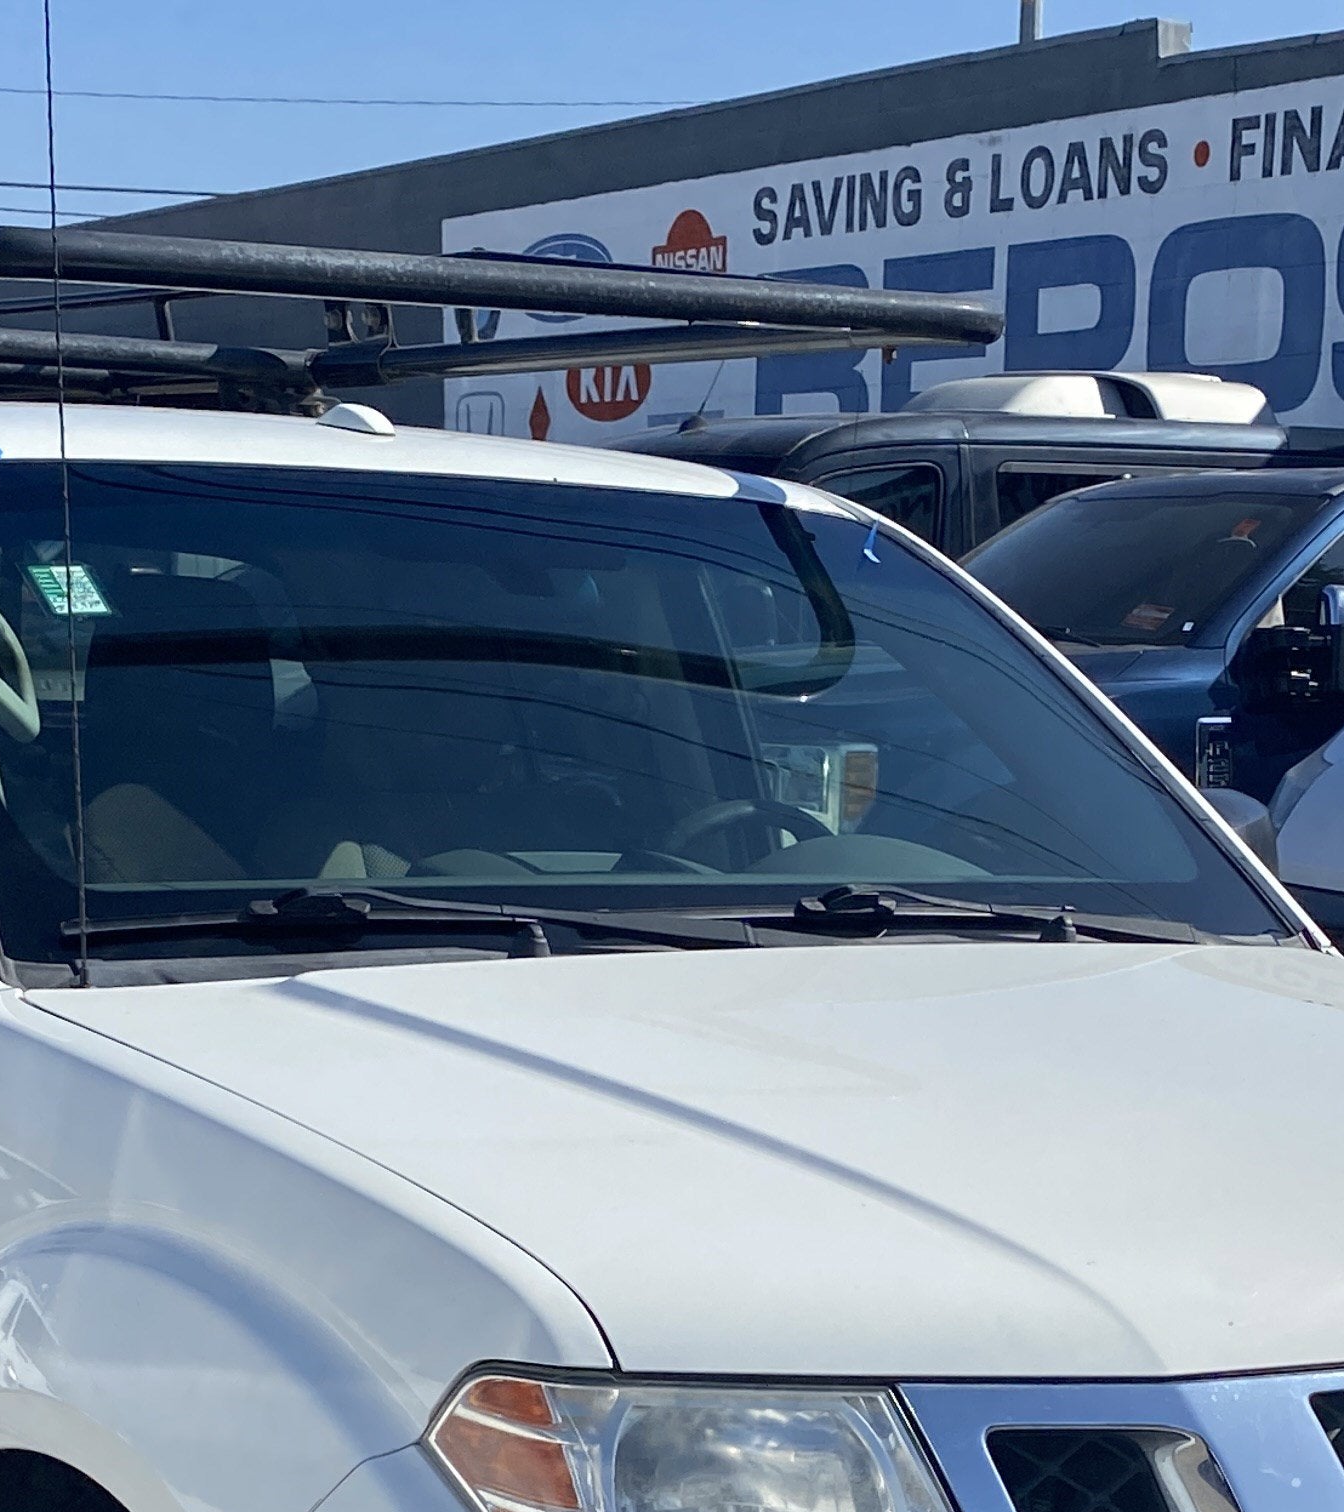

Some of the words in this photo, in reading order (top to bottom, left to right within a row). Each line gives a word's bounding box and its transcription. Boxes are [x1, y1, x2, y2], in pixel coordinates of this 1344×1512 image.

[752, 164, 922, 247] SAVING
[943, 157, 973, 219] &
[990, 127, 1170, 213] LOANS
[579, 363, 640, 404] KIA
